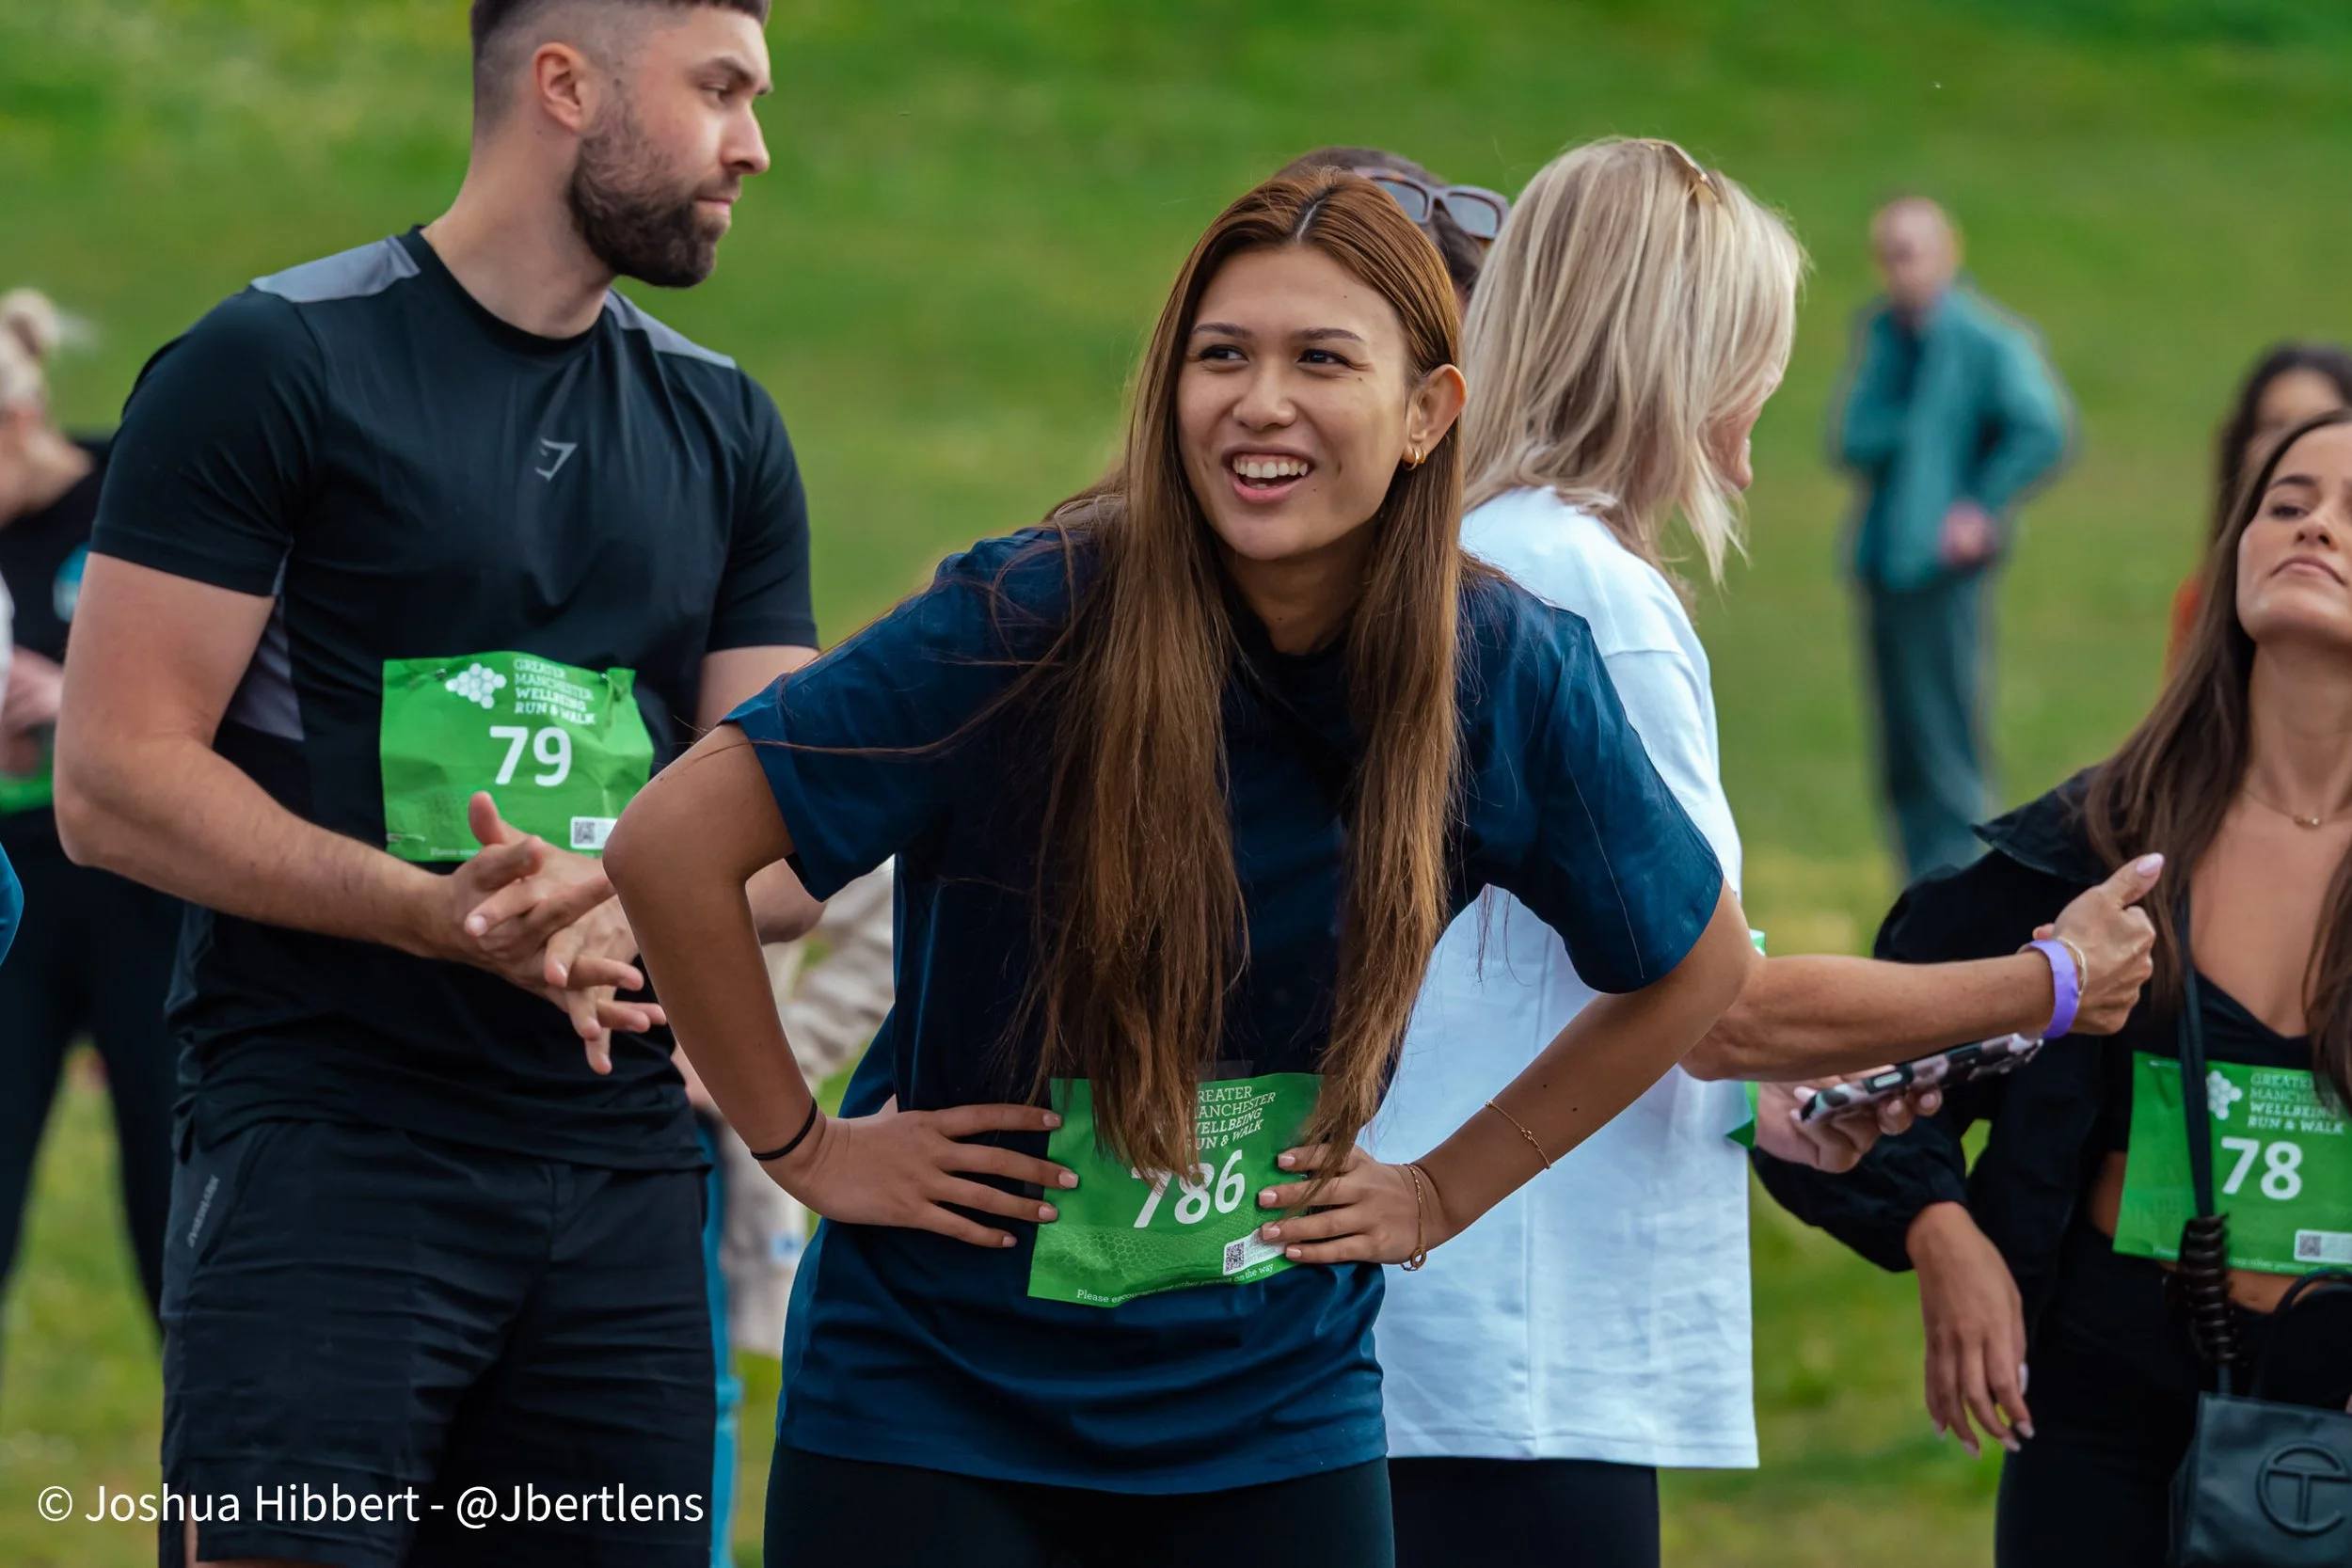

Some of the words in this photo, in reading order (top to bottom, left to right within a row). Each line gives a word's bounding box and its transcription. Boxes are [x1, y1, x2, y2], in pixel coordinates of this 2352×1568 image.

[515, 701, 548, 714] RUN
[560, 707, 596, 725] WALK
[489, 725, 572, 786] 79
[1197, 1085, 1253, 1103] REATER
[1195, 1136, 1218, 1151] UN
[1220, 1134, 1230, 1147] &
[1232, 1119, 1264, 1142] WALK
[2248, 1115, 2280, 1130] RUN
[2300, 1119, 2344, 1135] WALK
[2220, 1136, 2303, 1200] 78
[1131, 1149, 1245, 1228] 786
[1076, 1289, 1109, 1303] Please
[1234, 1275, 1246, 1283] on
[1245, 1268, 1258, 1280] the
[1258, 1262, 1274, 1275] way
